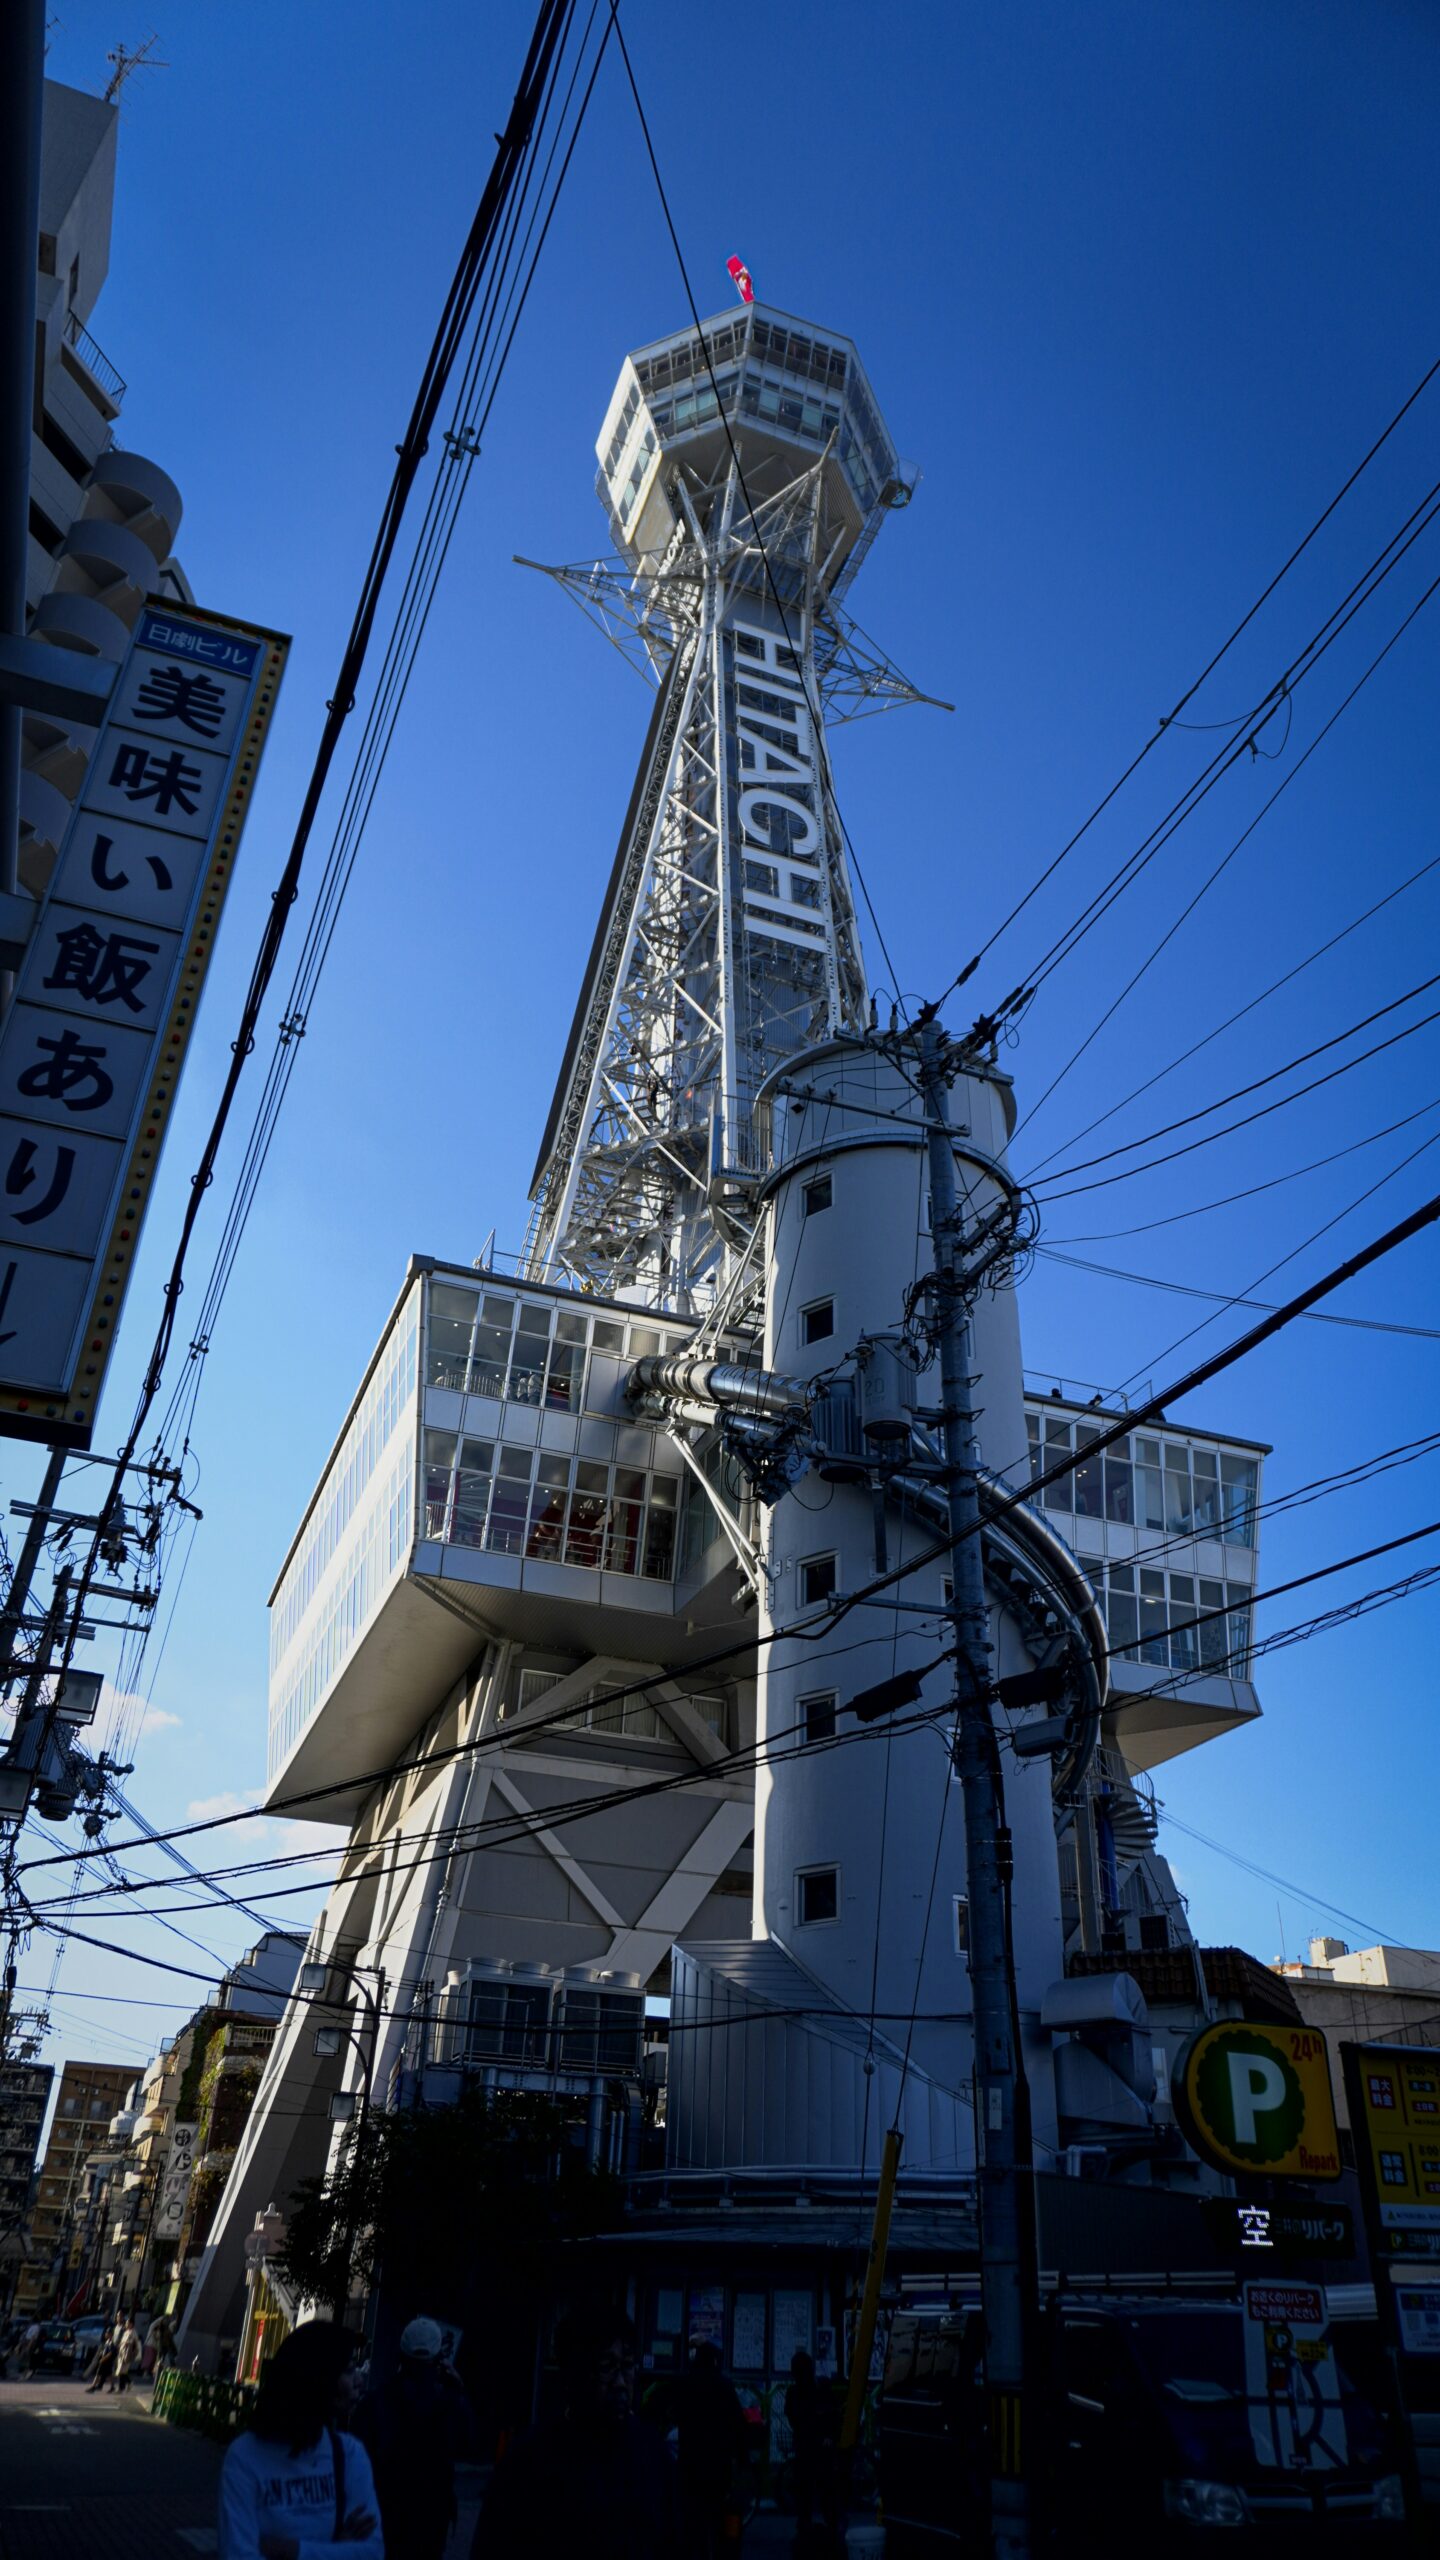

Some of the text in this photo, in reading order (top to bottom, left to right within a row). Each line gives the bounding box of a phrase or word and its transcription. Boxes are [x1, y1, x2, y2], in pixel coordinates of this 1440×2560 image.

[147, 623, 249, 664] 日劇ビル
[733, 619, 828, 954] HITACHI
[864, 1378, 885, 1397] 20
[1226, 2051, 1287, 2145] P
[1299, 2145, 1338, 2173] Repark
[1237, 2204, 1274, 2247] 空
[1276, 2333, 1289, 2349] P
